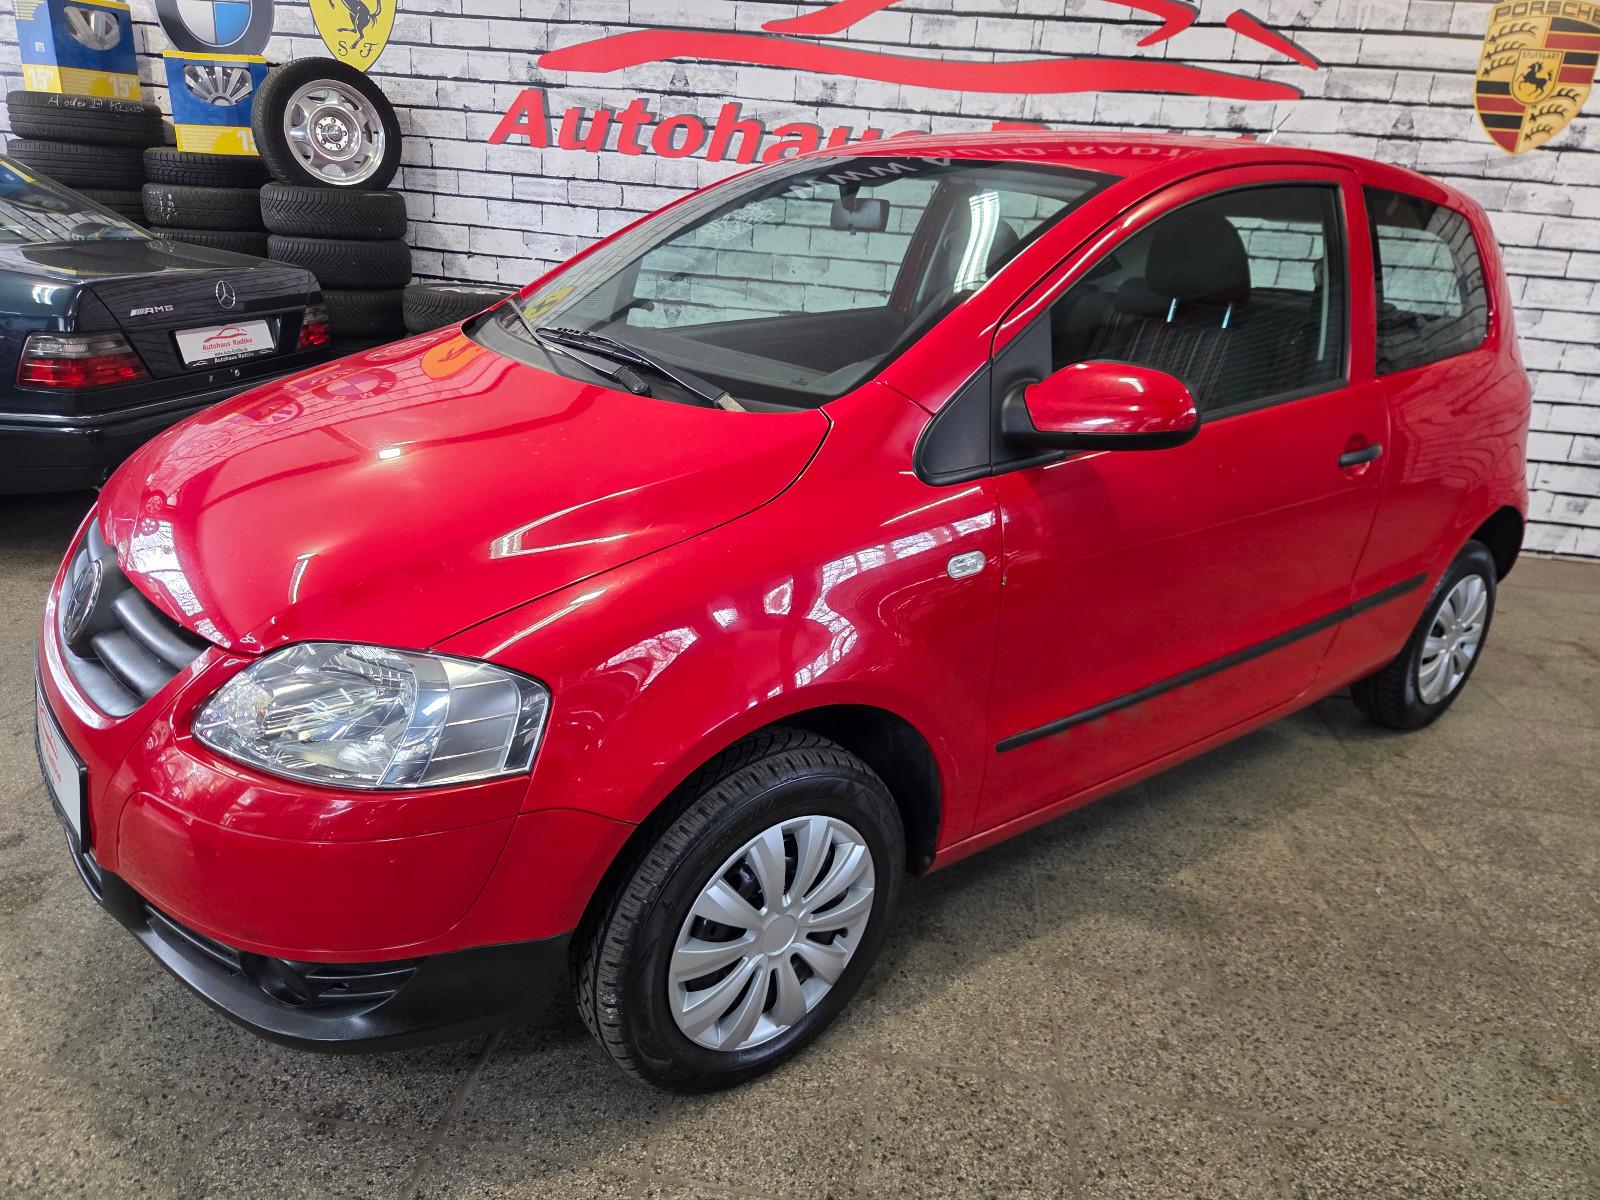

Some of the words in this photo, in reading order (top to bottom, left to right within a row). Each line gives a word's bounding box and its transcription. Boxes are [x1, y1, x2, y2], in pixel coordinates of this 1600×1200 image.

[1494, 1, 1600, 26] PORSCHE
[338, 41, 349, 56] S
[487, 88, 938, 165] Autoha
[144, 305, 174, 314] AMG
